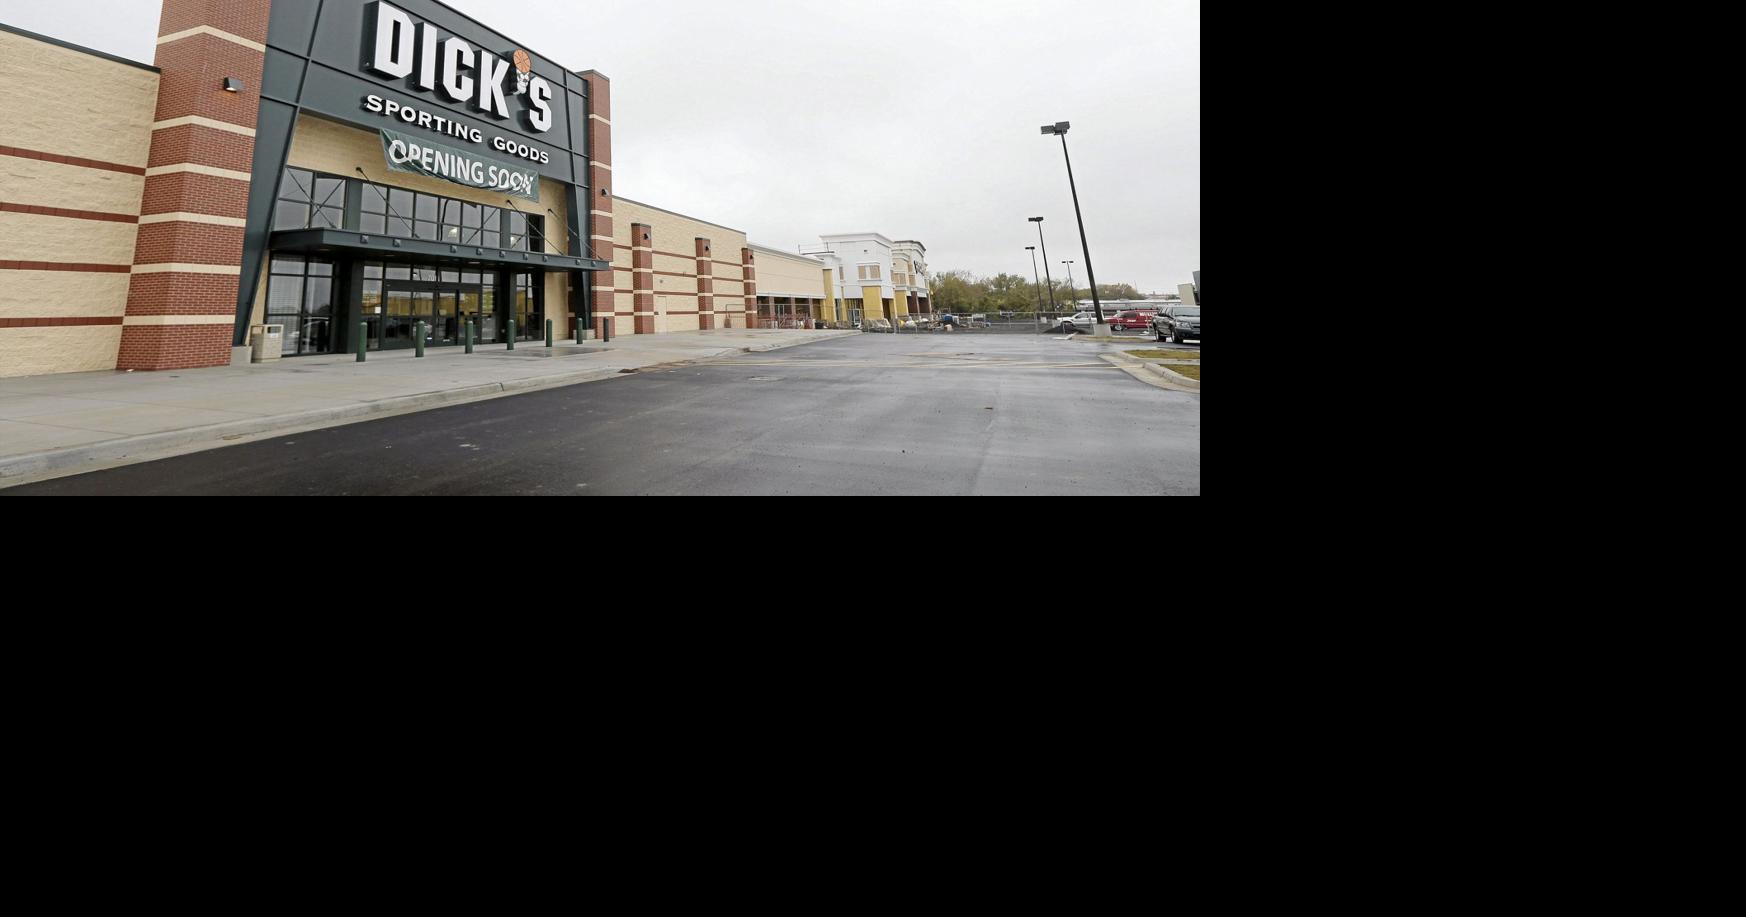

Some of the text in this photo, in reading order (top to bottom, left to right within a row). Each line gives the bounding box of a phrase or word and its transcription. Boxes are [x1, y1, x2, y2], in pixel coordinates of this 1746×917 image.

[374, 1, 551, 132] DICK'S
[366, 94, 549, 164] SPORTING GOODS
[388, 139, 534, 195] OPENING SOON
